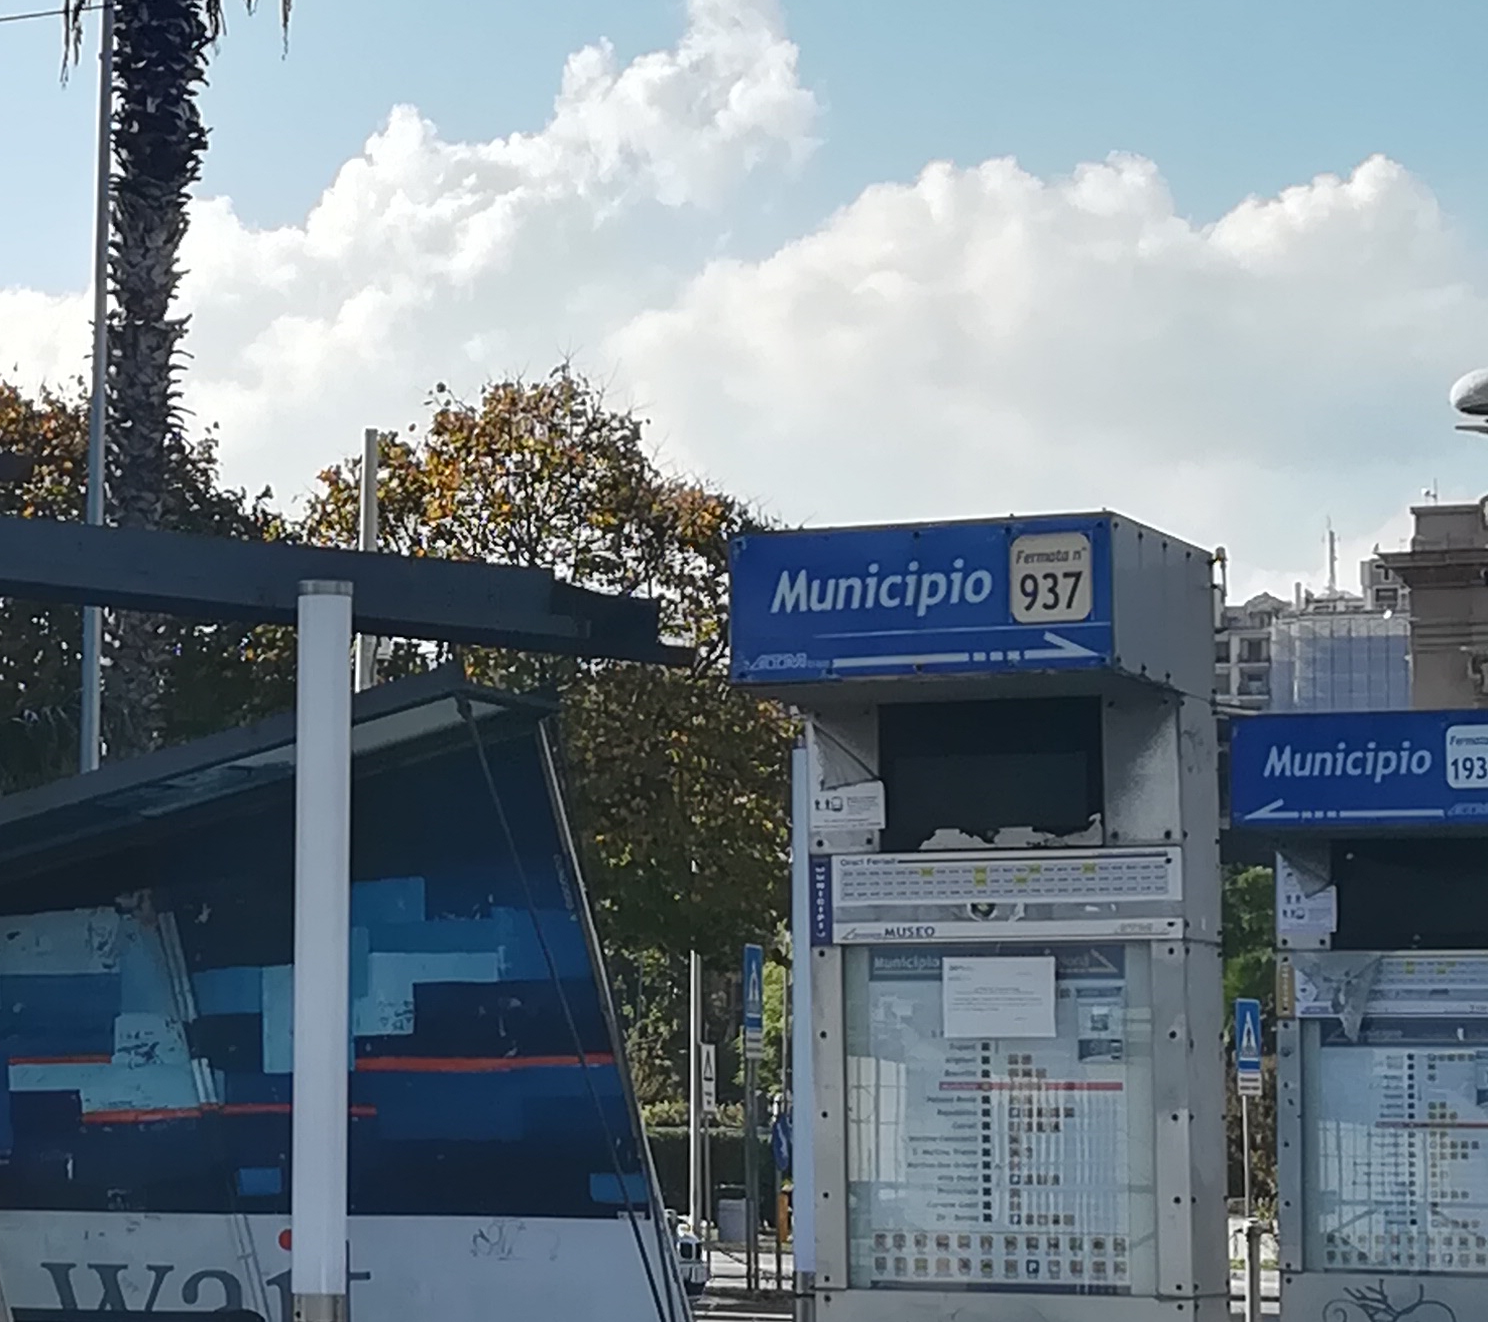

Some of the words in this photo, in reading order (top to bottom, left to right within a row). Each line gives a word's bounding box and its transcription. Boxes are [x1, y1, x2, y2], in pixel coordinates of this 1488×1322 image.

[1016, 549, 1070, 565] Fermata
[770, 558, 992, 617] Municipio
[1020, 570, 1083, 612] 937
[1264, 741, 1432, 783] Municipio
[884, 925, 936, 938] MUSEO
